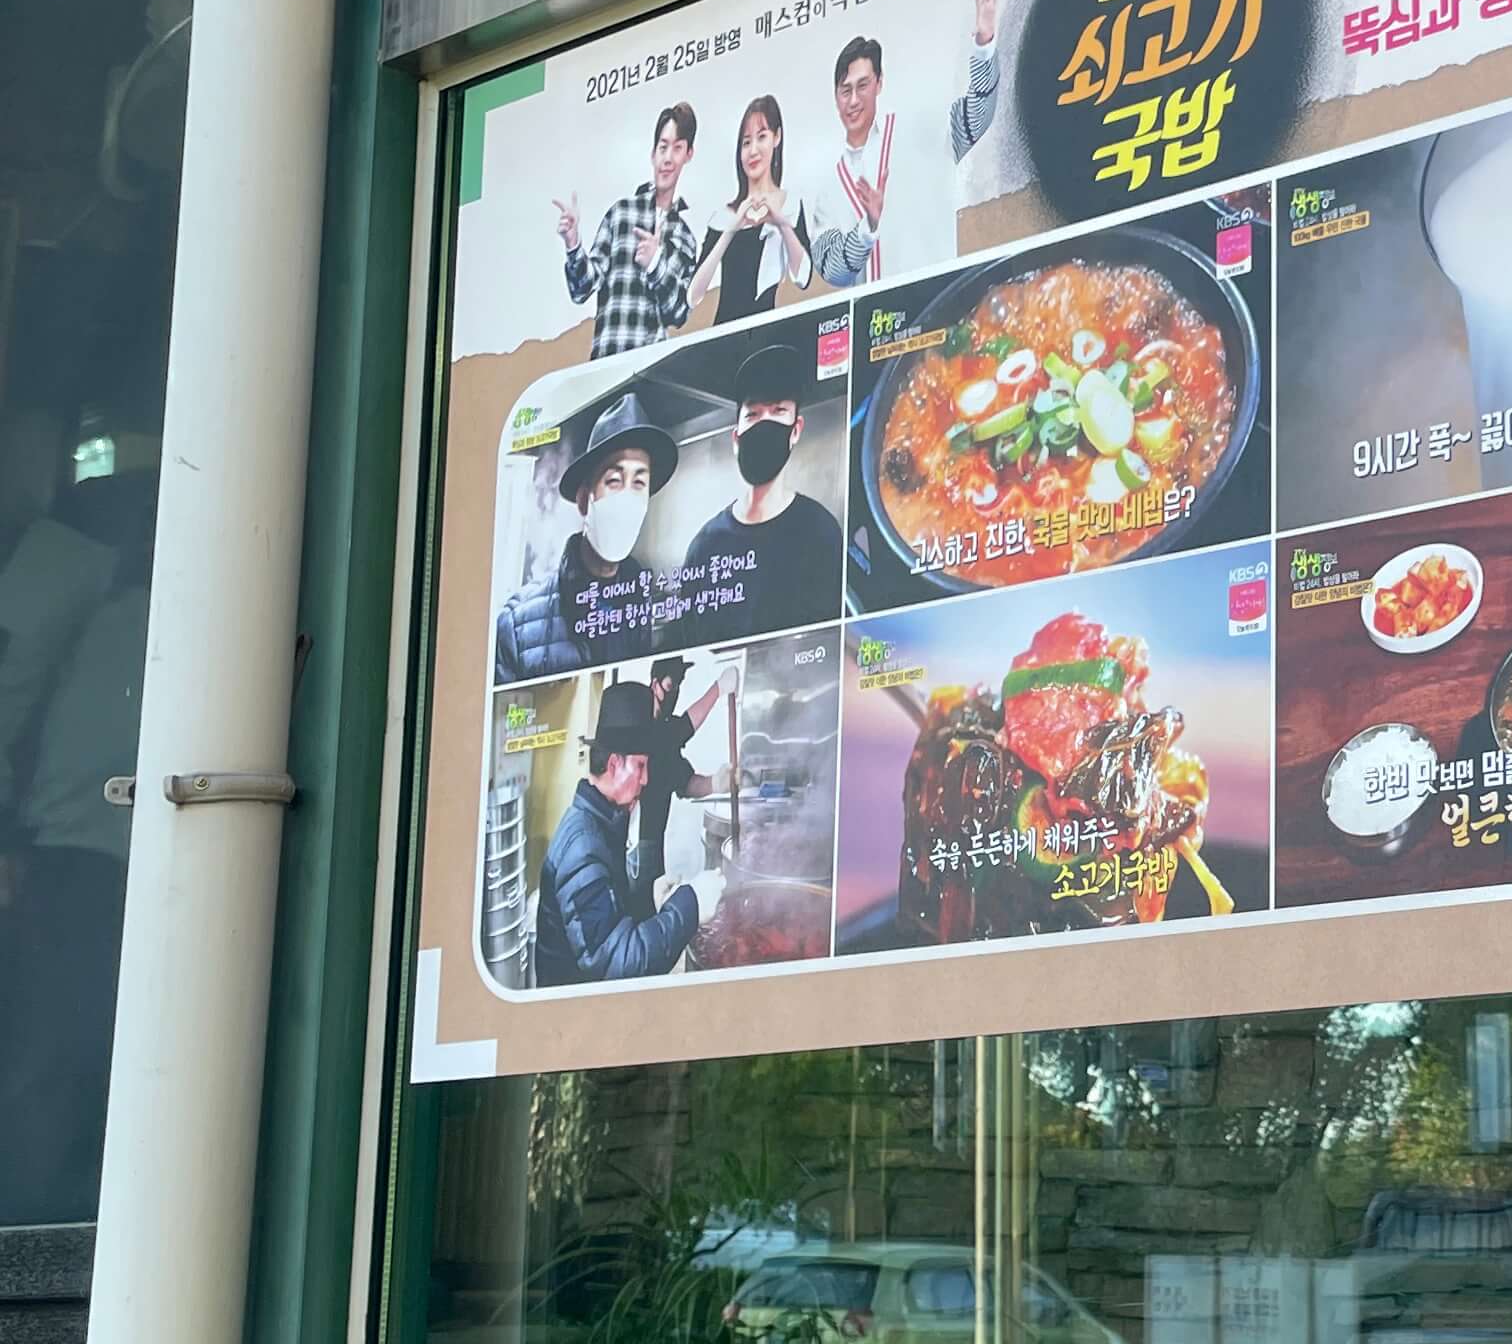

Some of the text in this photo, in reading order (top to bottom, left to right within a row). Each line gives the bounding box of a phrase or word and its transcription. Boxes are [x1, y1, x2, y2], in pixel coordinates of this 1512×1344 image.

[585, 64, 642, 104] 2021년
[643, 54, 670, 82] 2월
[672, 37, 711, 73] 25일
[713, 26, 742, 58] 방영
[1091, 69, 1237, 192] 국밥
[1352, 430, 1421, 479] 9시간
[909, 484, 1197, 576] 고소하고 진한 국물 맛의 비법은?
[575, 549, 758, 609] 대를 이어서 할 수 있어서 좋았어요
[574, 608, 623, 639] 아들한텐
[625, 601, 652, 630] 항상
[694, 582, 746, 614] 생각해요
[1361, 764, 1410, 804] 한번
[1415, 755, 1476, 798] 맛보면
[929, 817, 1120, 873] 속을 든든하게 채워주는
[1050, 847, 1178, 901] 소고기국밥
